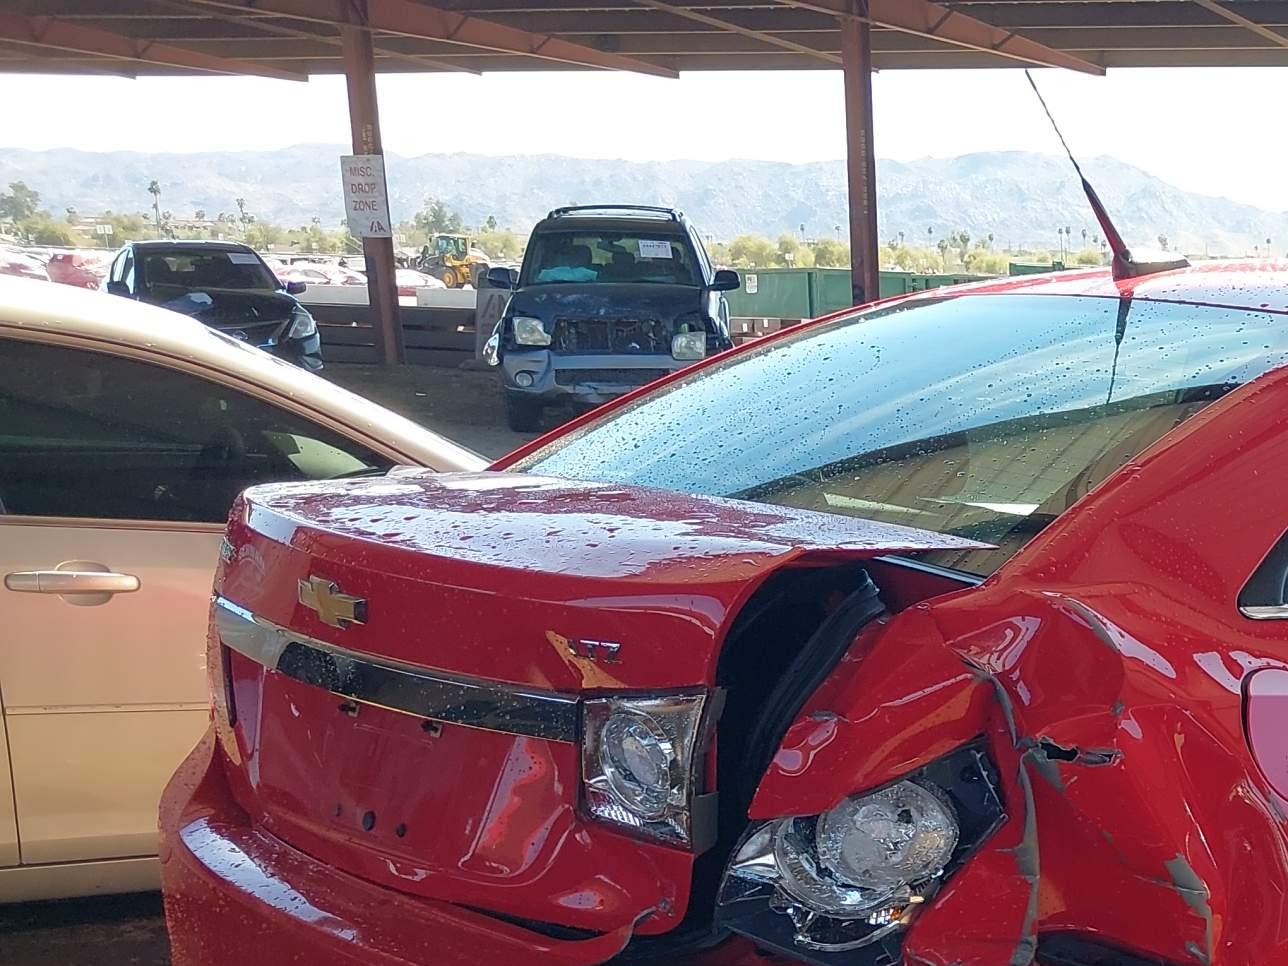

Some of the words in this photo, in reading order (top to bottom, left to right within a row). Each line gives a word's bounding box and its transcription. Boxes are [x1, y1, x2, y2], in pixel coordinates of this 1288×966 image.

[349, 166, 375, 177] MISC.
[351, 183, 377, 194] DROP
[352, 200, 378, 211] ZONE
[567, 639, 623, 664] LTZ
